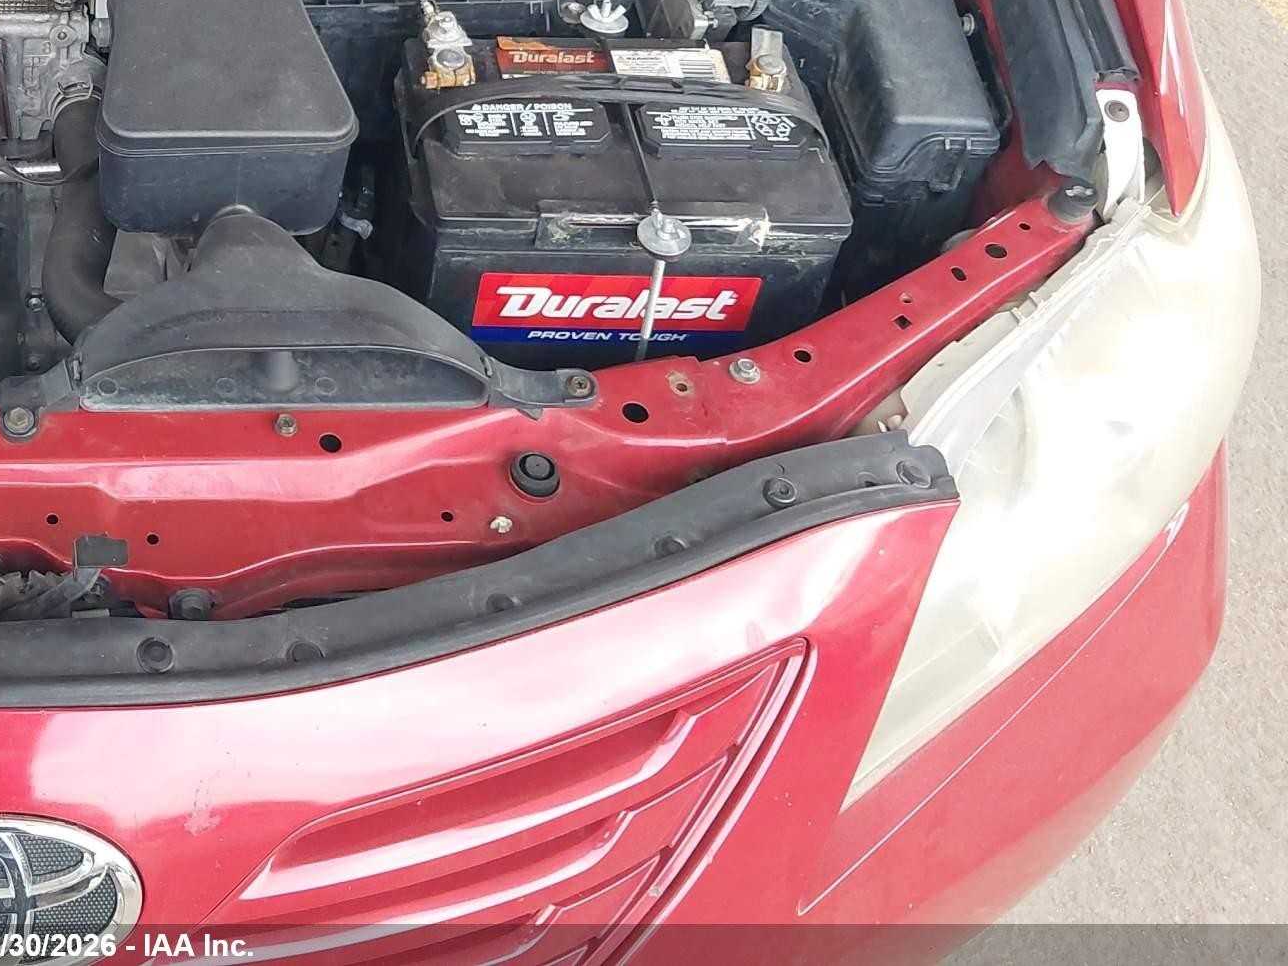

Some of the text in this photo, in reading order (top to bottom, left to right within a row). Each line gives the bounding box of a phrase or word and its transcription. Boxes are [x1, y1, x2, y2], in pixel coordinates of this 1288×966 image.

[508, 50, 595, 65] Duralast
[482, 103, 524, 111] DANGER
[534, 103, 572, 111] POISON
[496, 285, 738, 321] Duralast
[527, 330, 687, 342] PROVEN TOUGH
